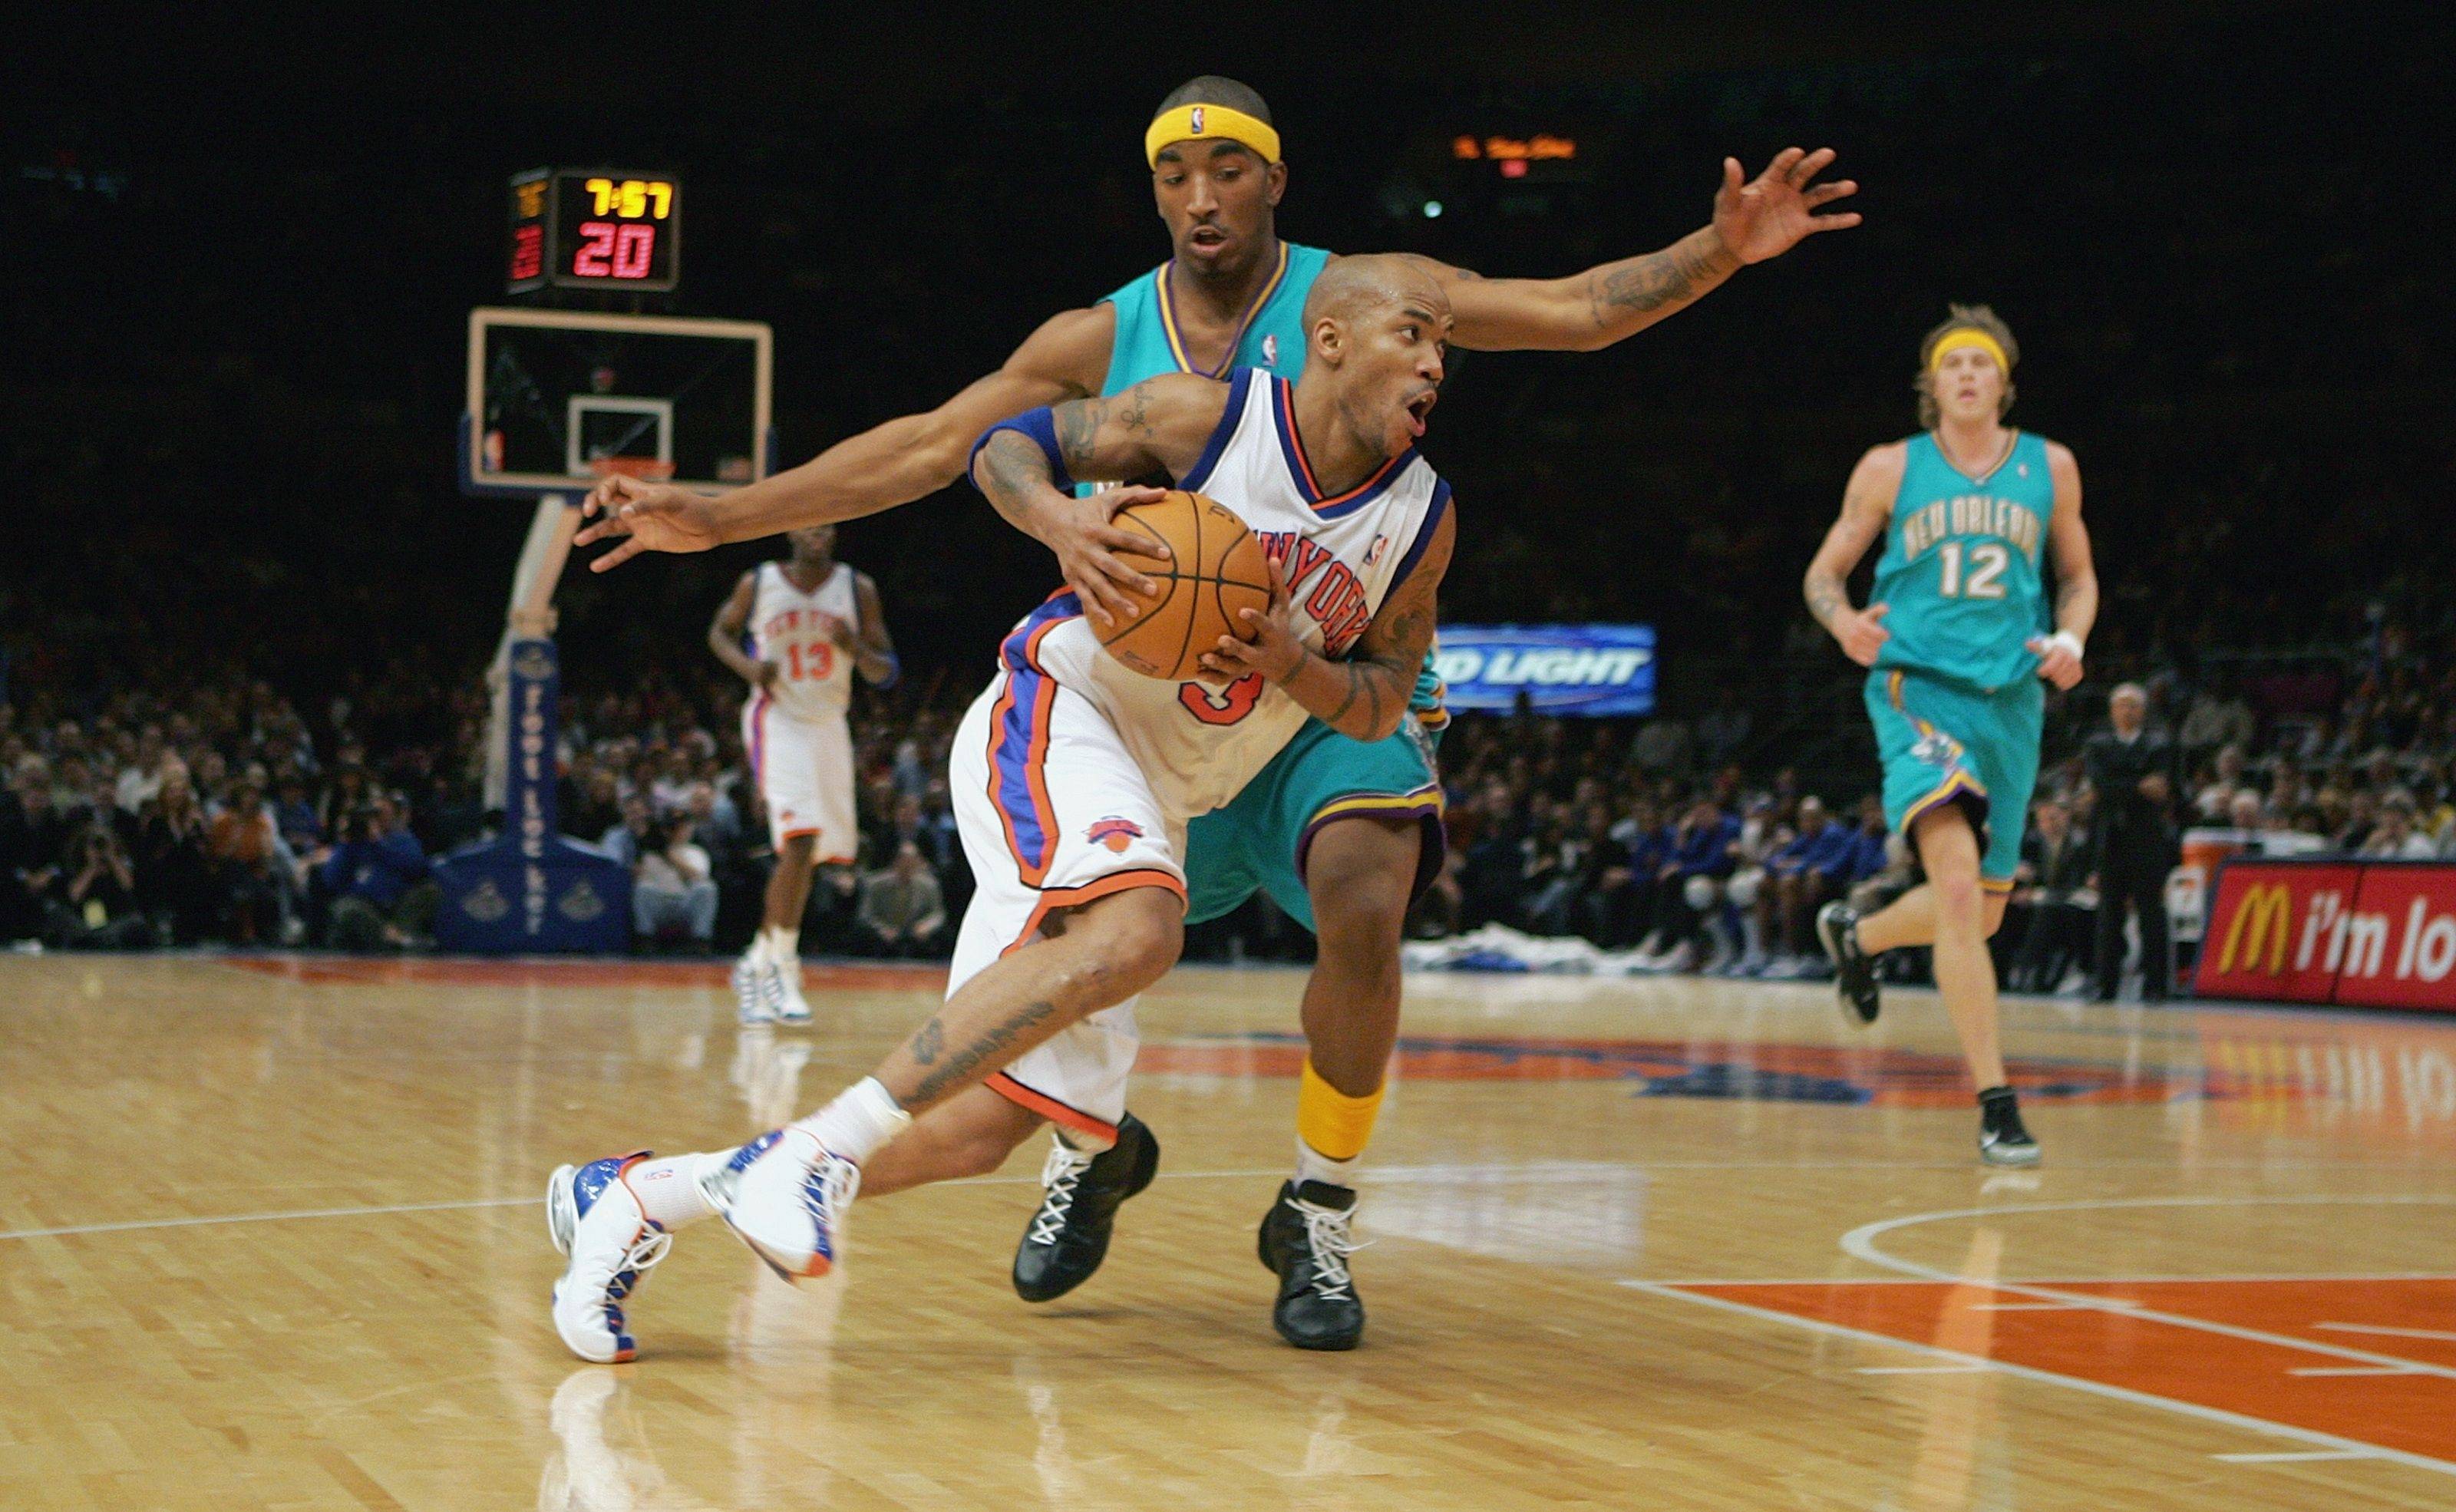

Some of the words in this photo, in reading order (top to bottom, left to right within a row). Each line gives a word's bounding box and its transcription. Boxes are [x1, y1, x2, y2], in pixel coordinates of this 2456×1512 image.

[585, 178, 672, 220] 7:57
[573, 222, 655, 279] 20
[1939, 542, 2008, 599] 12
[787, 642, 834, 682] 13
[1483, 647, 1652, 685] LIGHT
[2294, 890, 2389, 979] i'm
